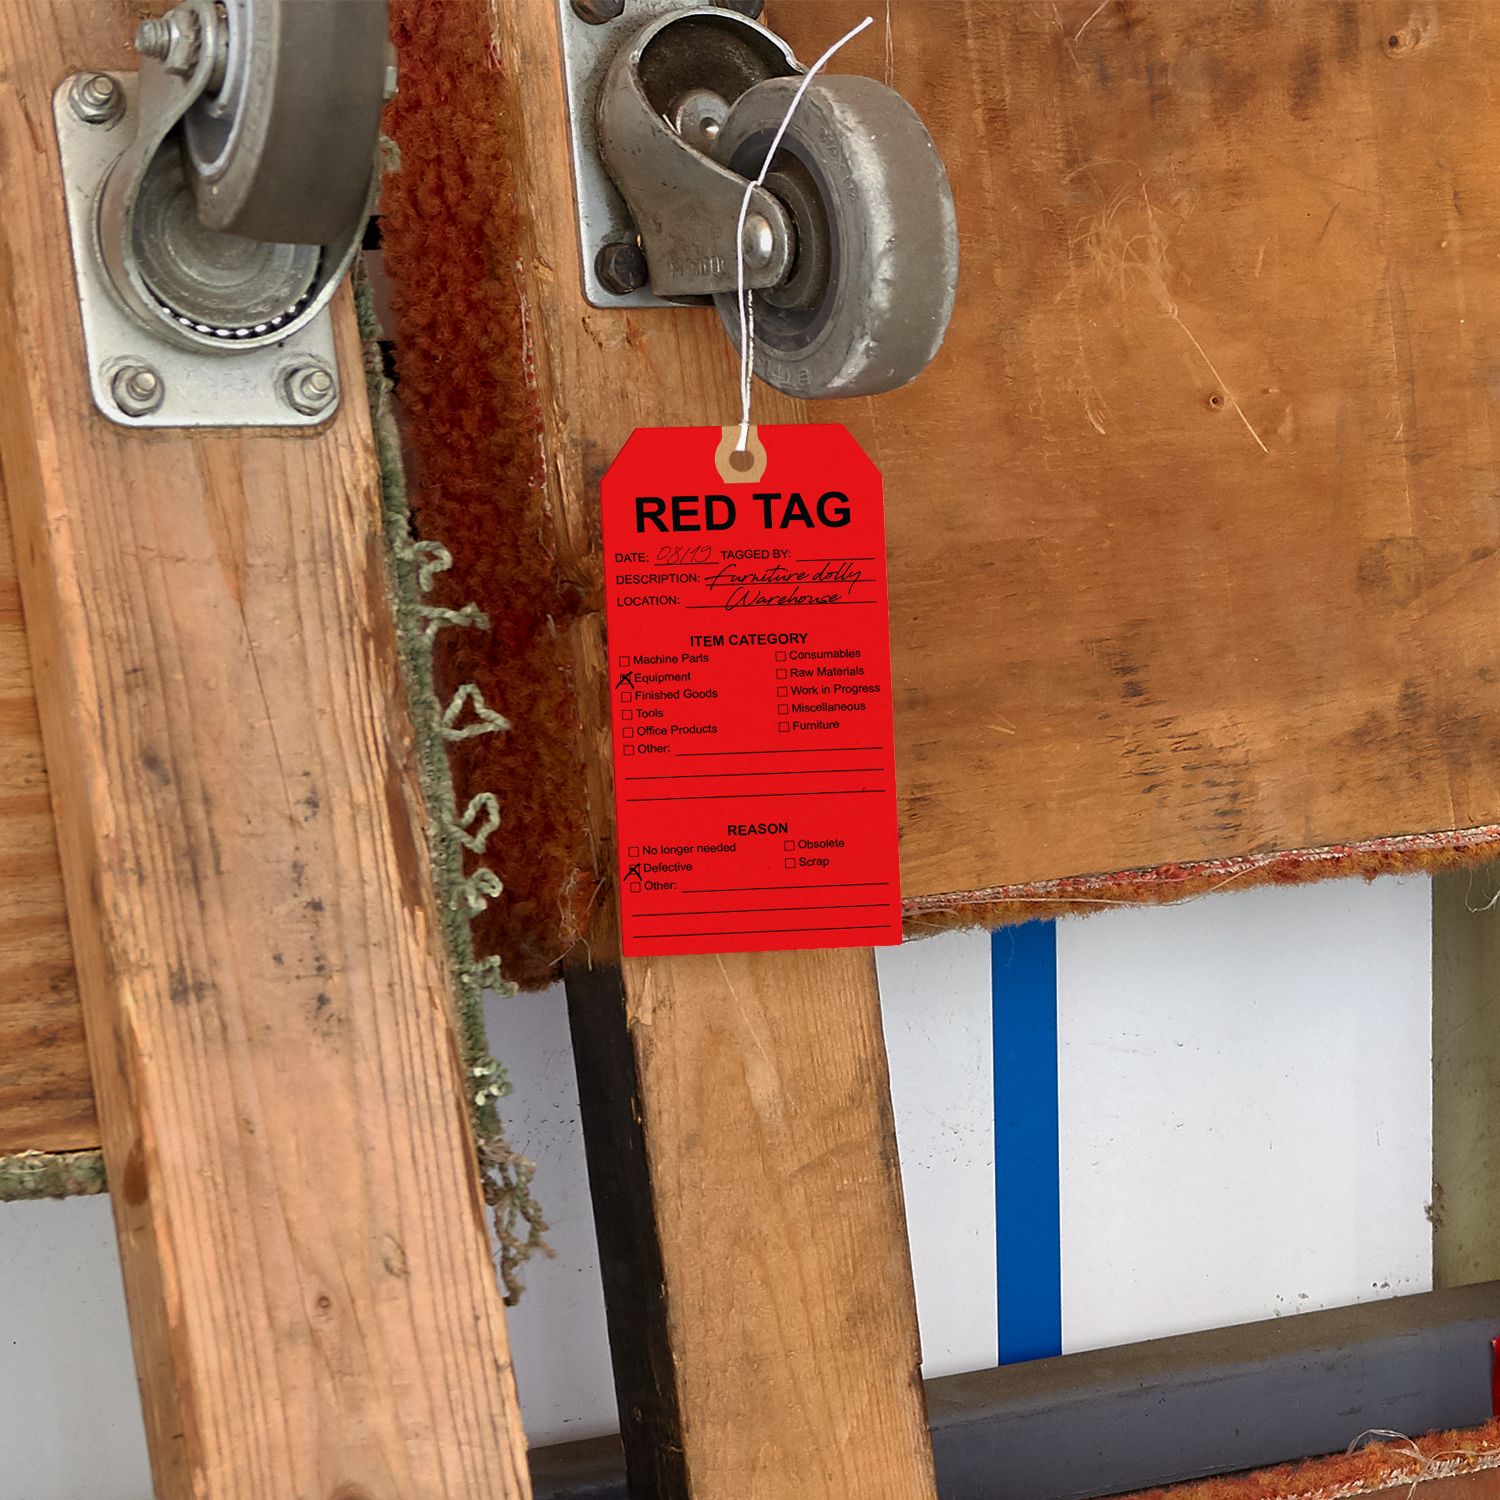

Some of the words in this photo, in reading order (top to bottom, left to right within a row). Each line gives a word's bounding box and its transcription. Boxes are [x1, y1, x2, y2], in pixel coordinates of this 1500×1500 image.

[635, 494, 737, 533] RED
[752, 490, 851, 529] TAG
[614, 552, 650, 564] DATE:
[720, 549, 770, 561] TAGGED
[772, 548, 792, 560] BY:
[615, 572, 701, 585] DESCRIPTION:
[811, 562, 862, 594] dolly
[616, 595, 681, 608] LOCATION:
[724, 586, 842, 611] Warehouse
[689, 635, 725, 648] ITEM
[728, 632, 809, 647] CATEGORY
[633, 655, 679, 666] Machine
[681, 653, 710, 664] Parts
[788, 648, 862, 661] Consumables
[633, 671, 692, 685] Equipment
[789, 667, 814, 679] Raw
[815, 665, 865, 678] Materials
[634, 690, 681, 701] Finished
[682, 688, 719, 700] Goods
[790, 685, 820, 697] Work
[821, 684, 832, 696] in
[833, 683, 881, 697] Progress
[636, 708, 664, 719] Tools
[791, 701, 867, 714] Miscellaneous
[636, 725, 668, 737] Office
[670, 723, 718, 736] Products
[792, 719, 841, 731] Furniture
[637, 743, 671, 755] Other:
[727, 822, 789, 837] REASON
[642, 846, 658, 856] No
[659, 844, 695, 857] longer
[696, 842, 737, 854] needed
[797, 837, 846, 850] Obsolete
[643, 861, 694, 873] Defective
[798, 856, 831, 869] Scrap
[643, 880, 678, 892] Other:
